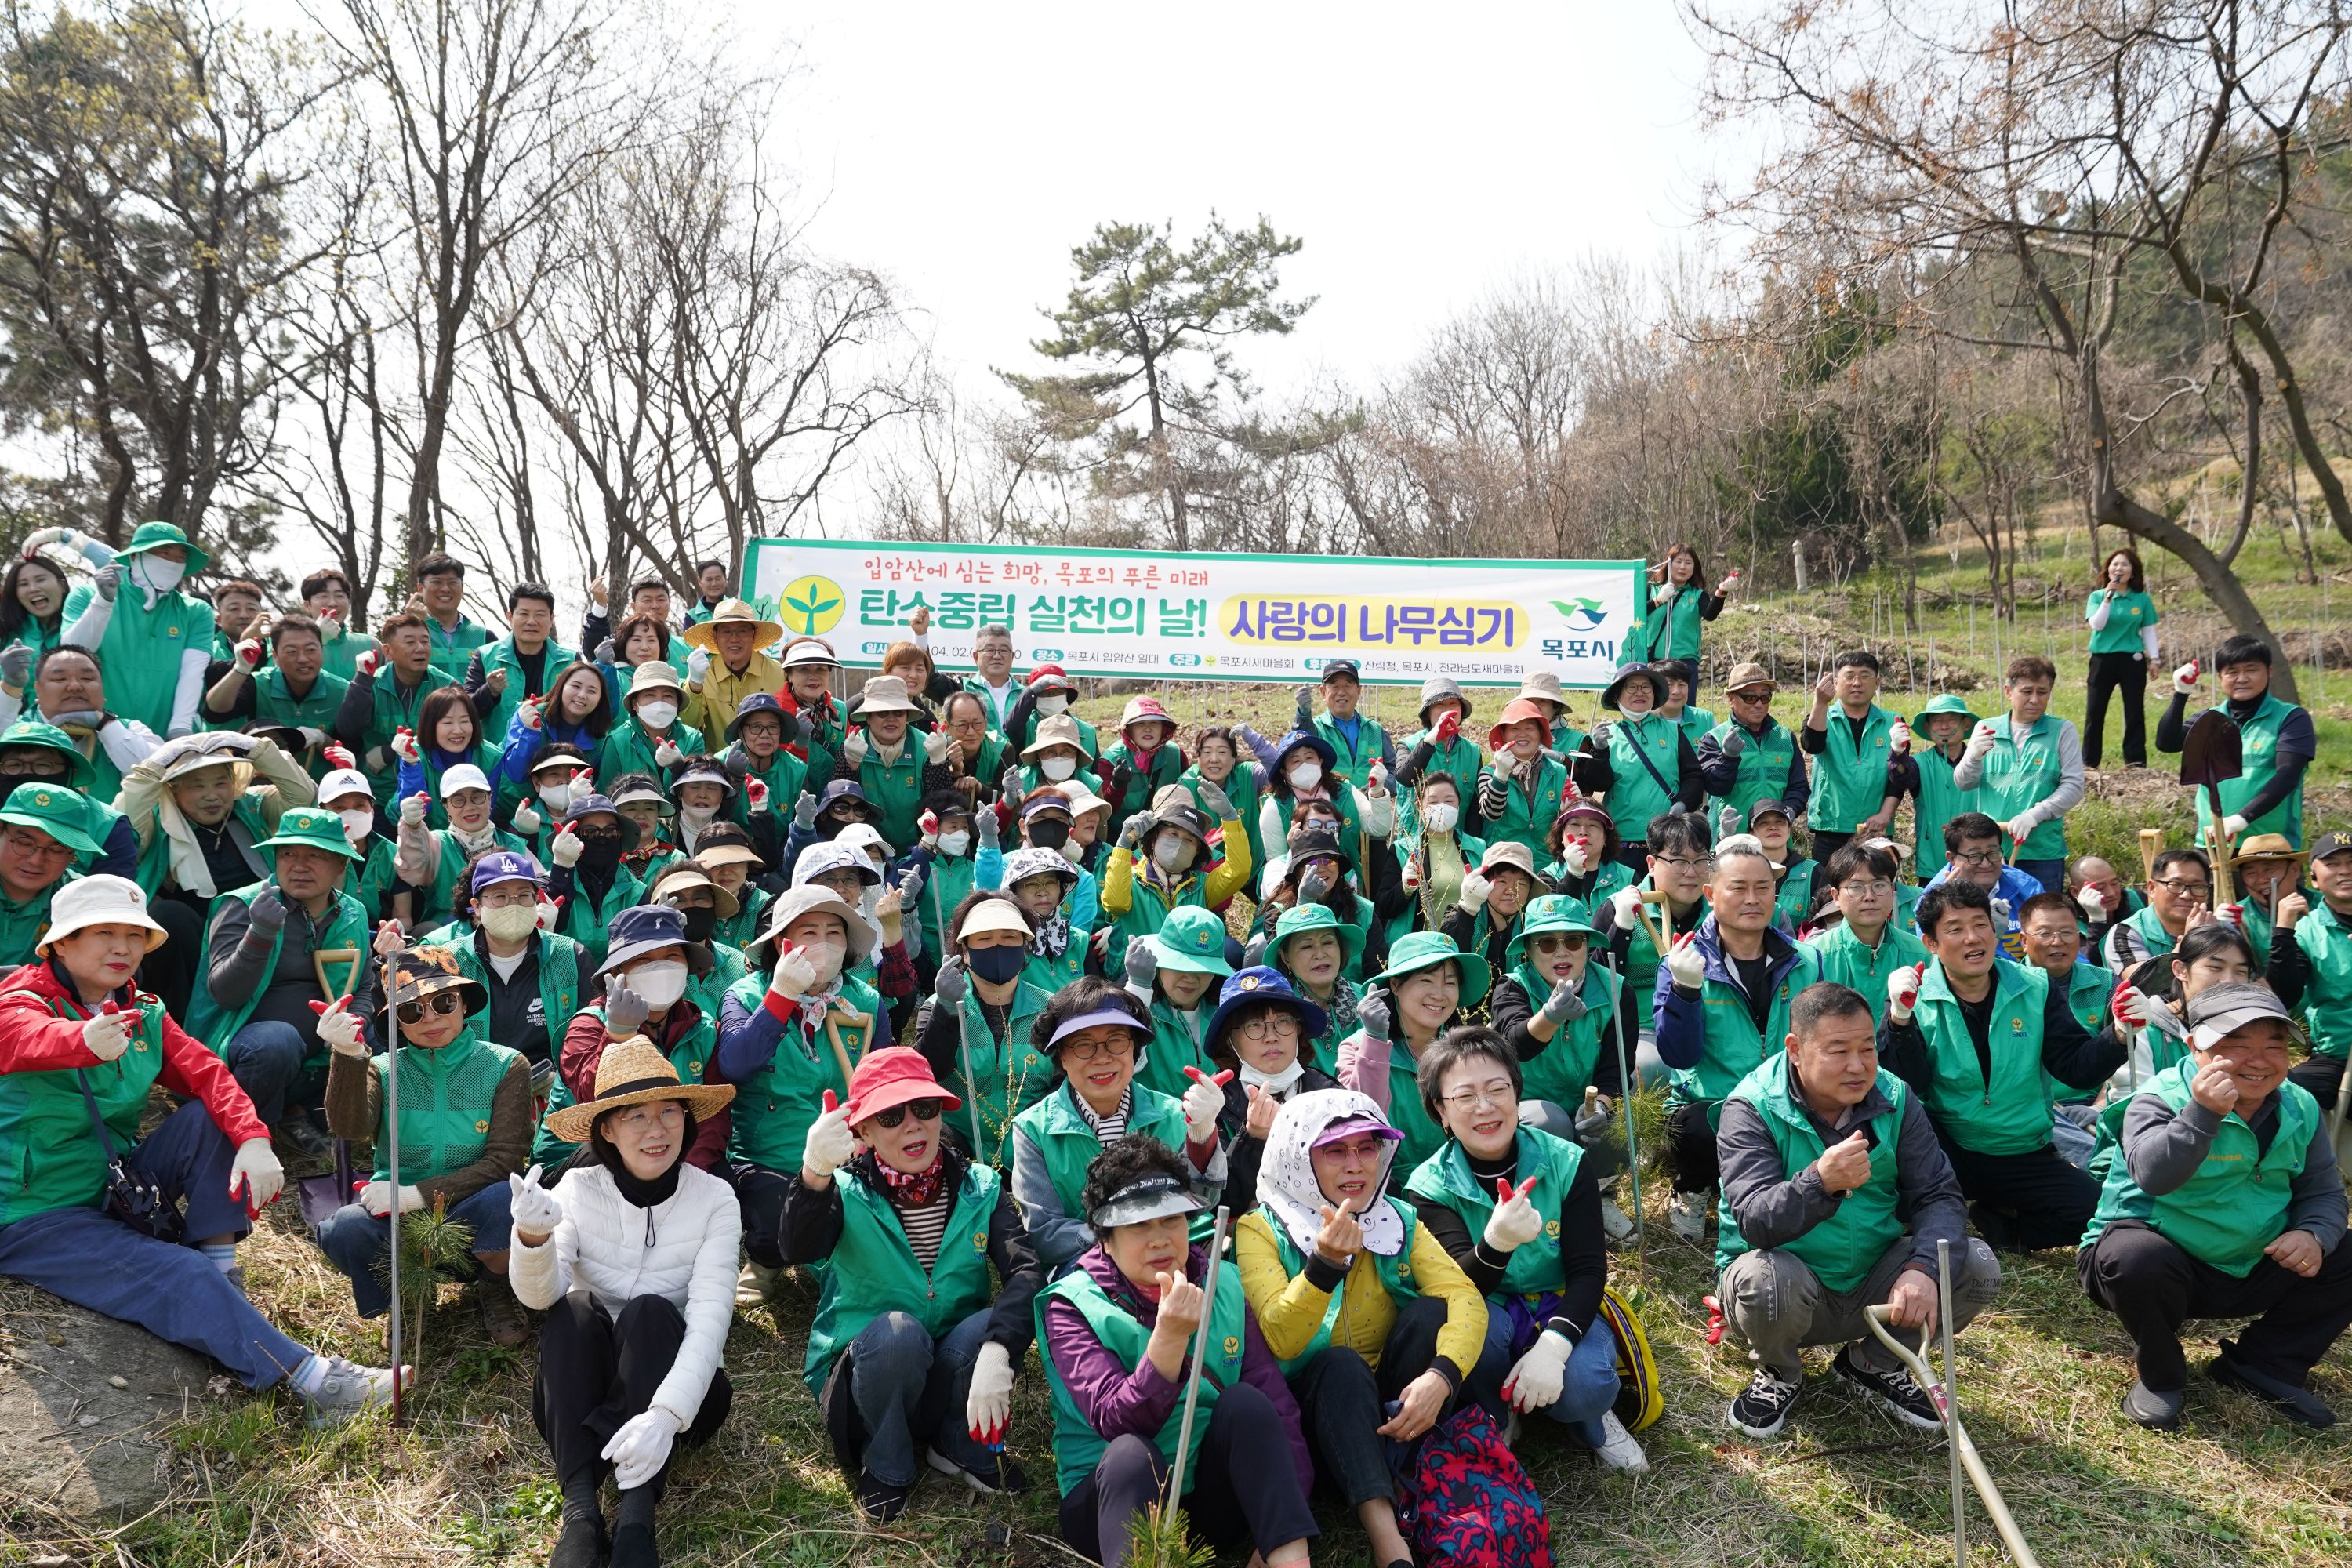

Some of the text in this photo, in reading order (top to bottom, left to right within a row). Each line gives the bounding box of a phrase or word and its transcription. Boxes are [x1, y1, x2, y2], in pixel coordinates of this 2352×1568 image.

[865, 556, 1208, 590] 입암산에 심는 희망, 목포의 푸른 미래
[860, 590, 1514, 648] 탄소중립 실천의 날! 사랑의 나무심기
[1036, 649, 1058, 661] 장소
[1067, 651, 1099, 662] 목포시
[1102, 652, 1134, 664] 입암산
[1138, 654, 1159, 665] 일대
[1174, 654, 1196, 666] 주관
[1220, 656, 1294, 669] 목포시새마을회
[1364, 661, 1399, 673] 산림청,
[1402, 662, 1436, 673] 목포시,
[1439, 663, 1524, 675] 전라남도새마을회
[1541, 639, 1613, 661] 목포시
[499, 855, 518, 872] LA
[129, 891, 140, 903] C
